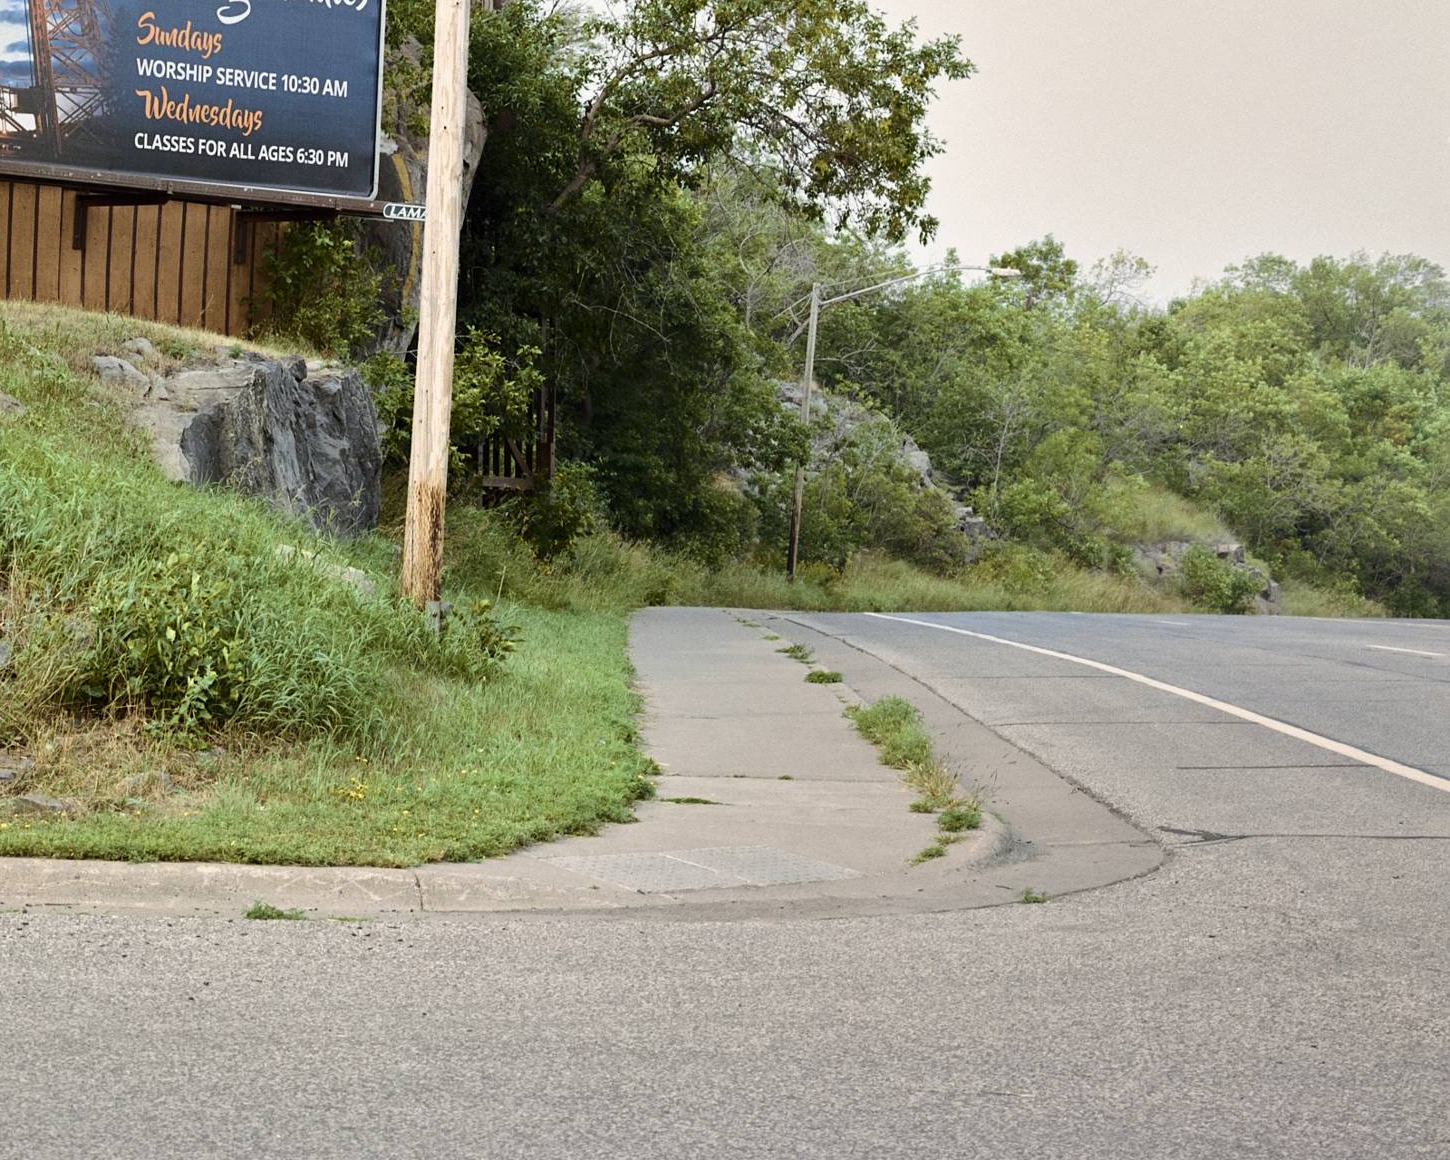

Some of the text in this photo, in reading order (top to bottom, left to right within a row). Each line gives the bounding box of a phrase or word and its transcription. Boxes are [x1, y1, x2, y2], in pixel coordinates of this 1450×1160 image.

[136, 11, 223, 59] Sundays
[136, 57, 348, 98] WORSHIP SERVICE 10:30 AM
[135, 86, 263, 136] Wednesdays
[134, 133, 349, 168] CLASSES FOR ALL AGES 6:30 PM
